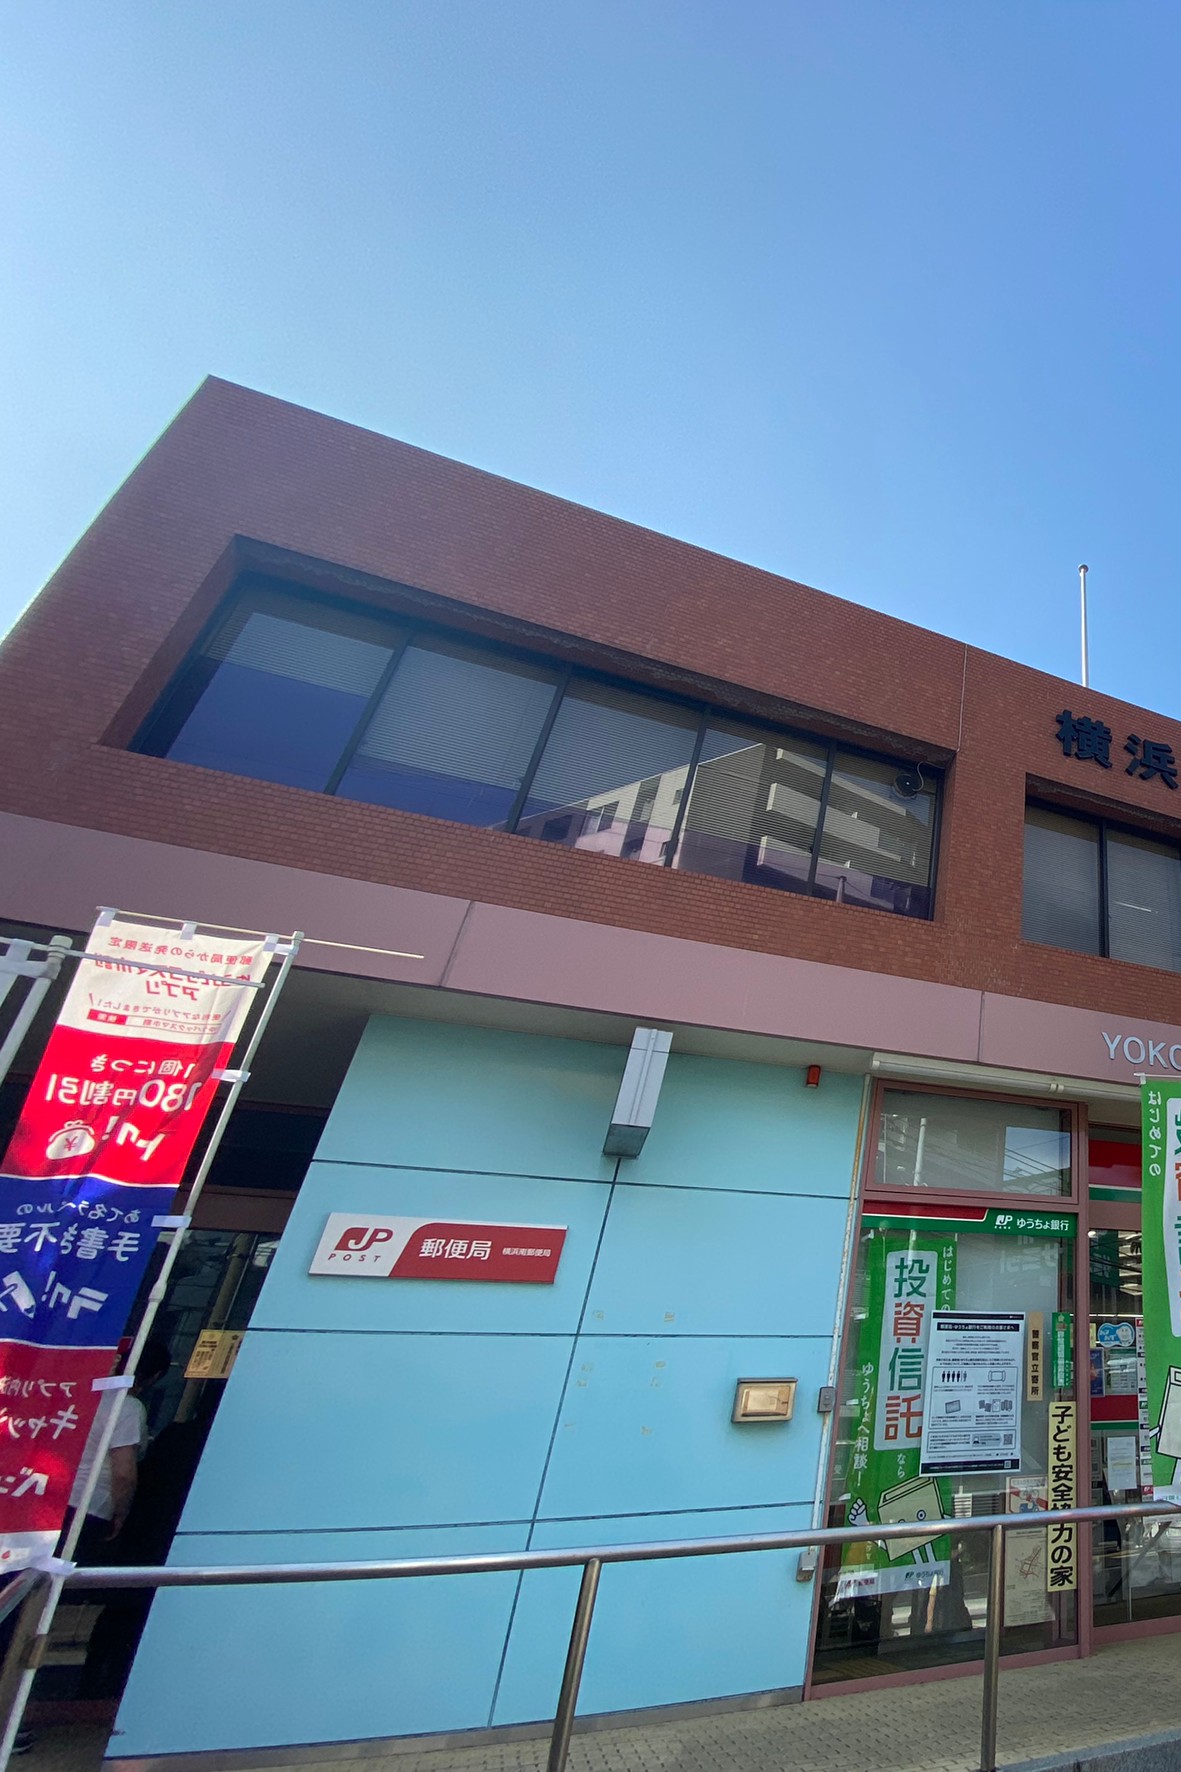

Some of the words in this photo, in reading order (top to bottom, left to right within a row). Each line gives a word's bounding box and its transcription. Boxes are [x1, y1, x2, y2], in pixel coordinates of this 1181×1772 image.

[1016, 1217, 1070, 1231] ゆうちょ銀行
[328, 1252, 382, 1263] POST
[419, 1237, 493, 1261] 郵便局
[884, 1257, 930, 1441] 投資信託
[1031, 1329, 1040, 1396] 警察官立寄所
